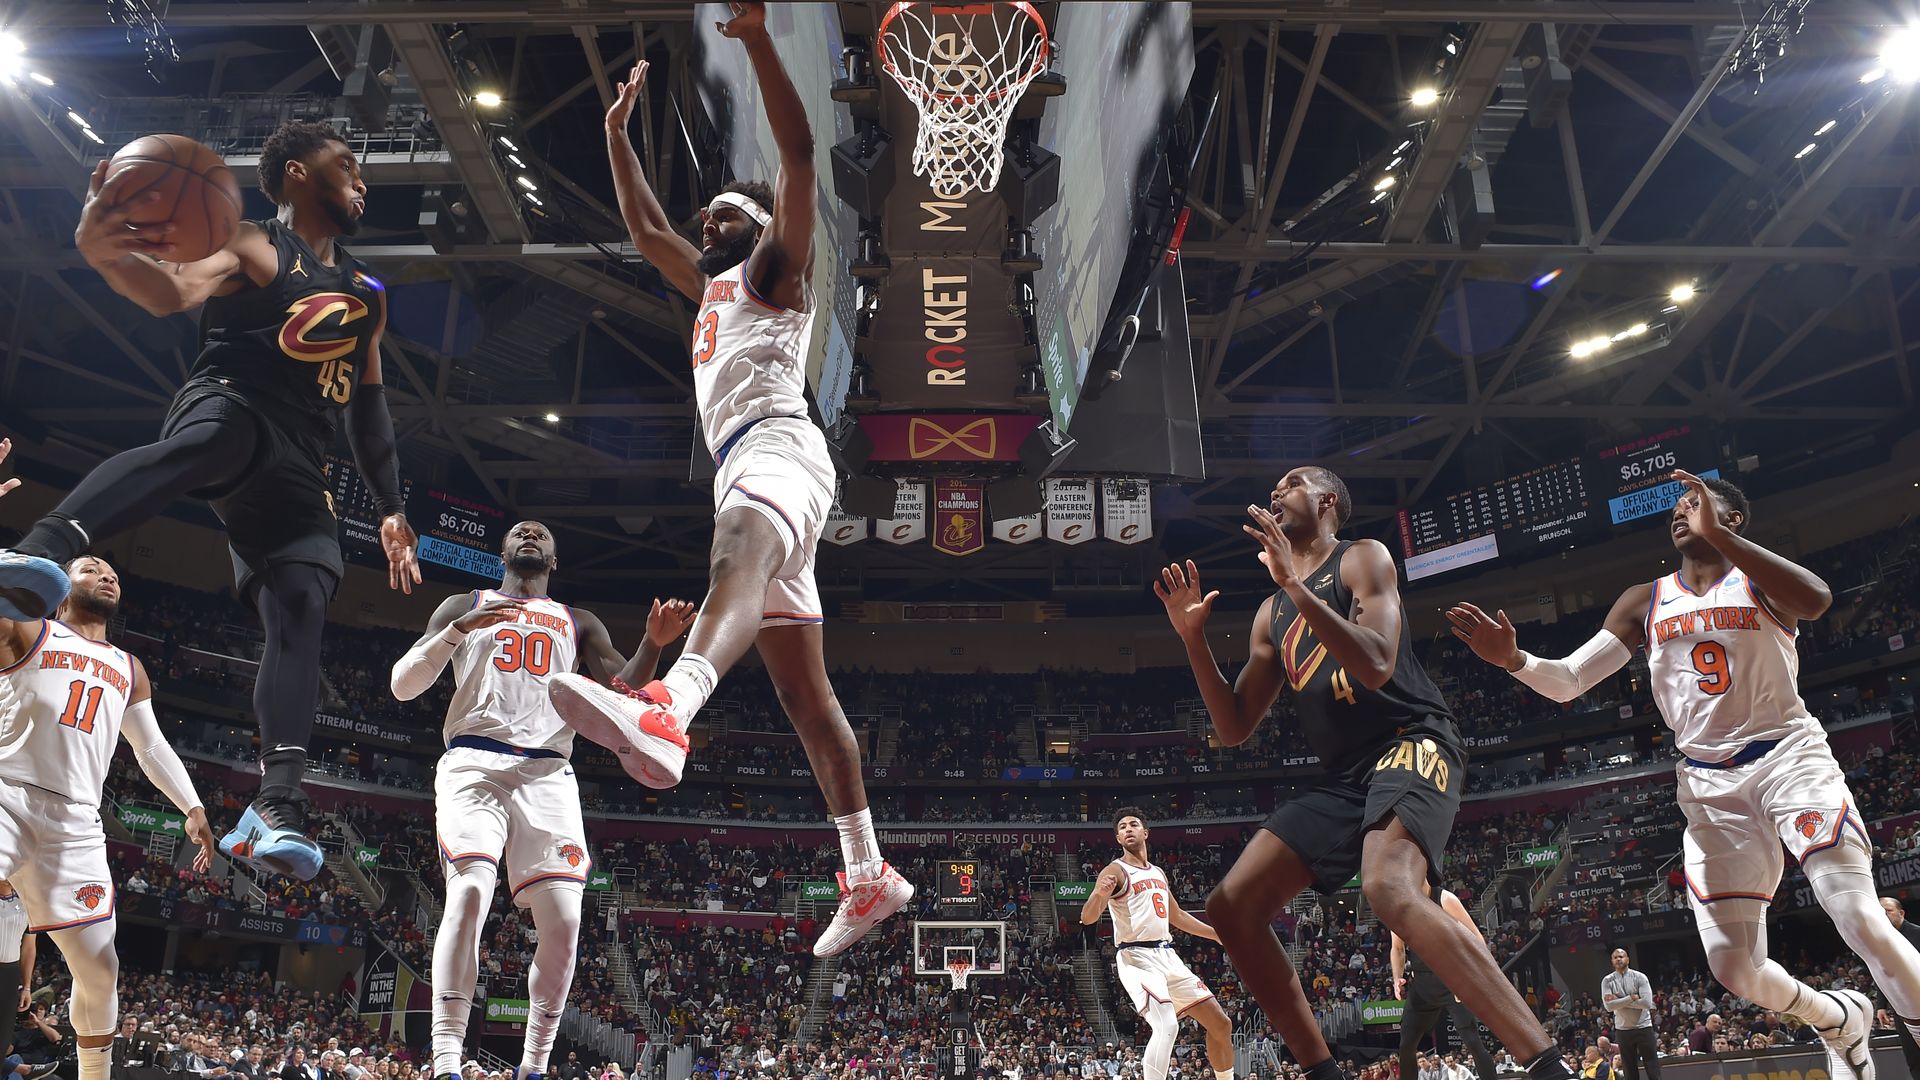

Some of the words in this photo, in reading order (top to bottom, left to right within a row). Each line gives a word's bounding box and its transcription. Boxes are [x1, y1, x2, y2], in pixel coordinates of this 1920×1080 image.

[692, 310, 719, 368] 23
[1049, 331, 1064, 389] Sprite
[318, 360, 352, 404] 45
[1620, 452, 1676, 480] $6,705
[938, 500, 979, 509] CHAMPIONS
[951, 493, 966, 501] NBA
[1623, 490, 1660, 508] OFFICIAL
[1566, 510, 1587, 522] JALEN
[1617, 502, 1658, 520] COMPANY
[1661, 499, 1672, 509] OF
[440, 513, 486, 537] $6,705
[422, 548, 457, 565] COMPANY
[460, 559, 469, 569] OF
[471, 562, 483, 573] THE
[485, 566, 503, 578] CAVS
[430, 540, 462, 557] OFFICIAL
[464, 550, 498, 567] CLEANING
[524, 611, 568, 638] YORK
[1655, 611, 1696, 646] NEW
[1700, 606, 1760, 632] YORK
[493, 628, 553, 676] 30
[40, 650, 90, 672] NEW
[90, 657, 130, 700] YORK
[1691, 640, 1732, 696] 9
[1330, 666, 1357, 704] 4
[59, 680, 104, 734] 11
[315, 713, 353, 730] STREAM
[355, 722, 379, 736] CAVS
[693, 764, 710, 772] TOL
[737, 767, 765, 775] FOULS
[874, 769, 887, 778] 56
[1044, 769, 1057, 778] 62
[1136, 768, 1164, 776] FOULS
[1192, 765, 1210, 773] TOL
[1283, 758, 1305, 766] LET
[1376, 738, 1449, 792] CAVS
[121, 810, 156, 825] Sprite
[878, 831, 947, 847] Huntington
[1023, 834, 1056, 844] CLUB
[950, 864, 974, 875] 9:48
[1879, 858, 1920, 888] GAMES
[806, 886, 834, 895] Sprite
[960, 875, 972, 895] 9
[1059, 886, 1086, 896] Sprite
[1132, 879, 1152, 895] NEW
[1591, 886, 1614, 895] Homes
[1152, 893, 1167, 918] 6
[206, 911, 219, 925] 11
[239, 918, 284, 934] ASSISTS
[305, 927, 320, 940] 10
[352, 937, 363, 947] 44
[1586, 927, 1600, 939] 56
[370, 981, 379, 991] IN
[380, 980, 394, 991] THE
[369, 992, 392, 1004] PAINT
[501, 1004, 530, 1018] Huntin
[1376, 1006, 1403, 1018] Huntin
[954, 1046, 965, 1055] GET
[955, 1056, 966, 1065] THE
[954, 1066, 966, 1076] APP
